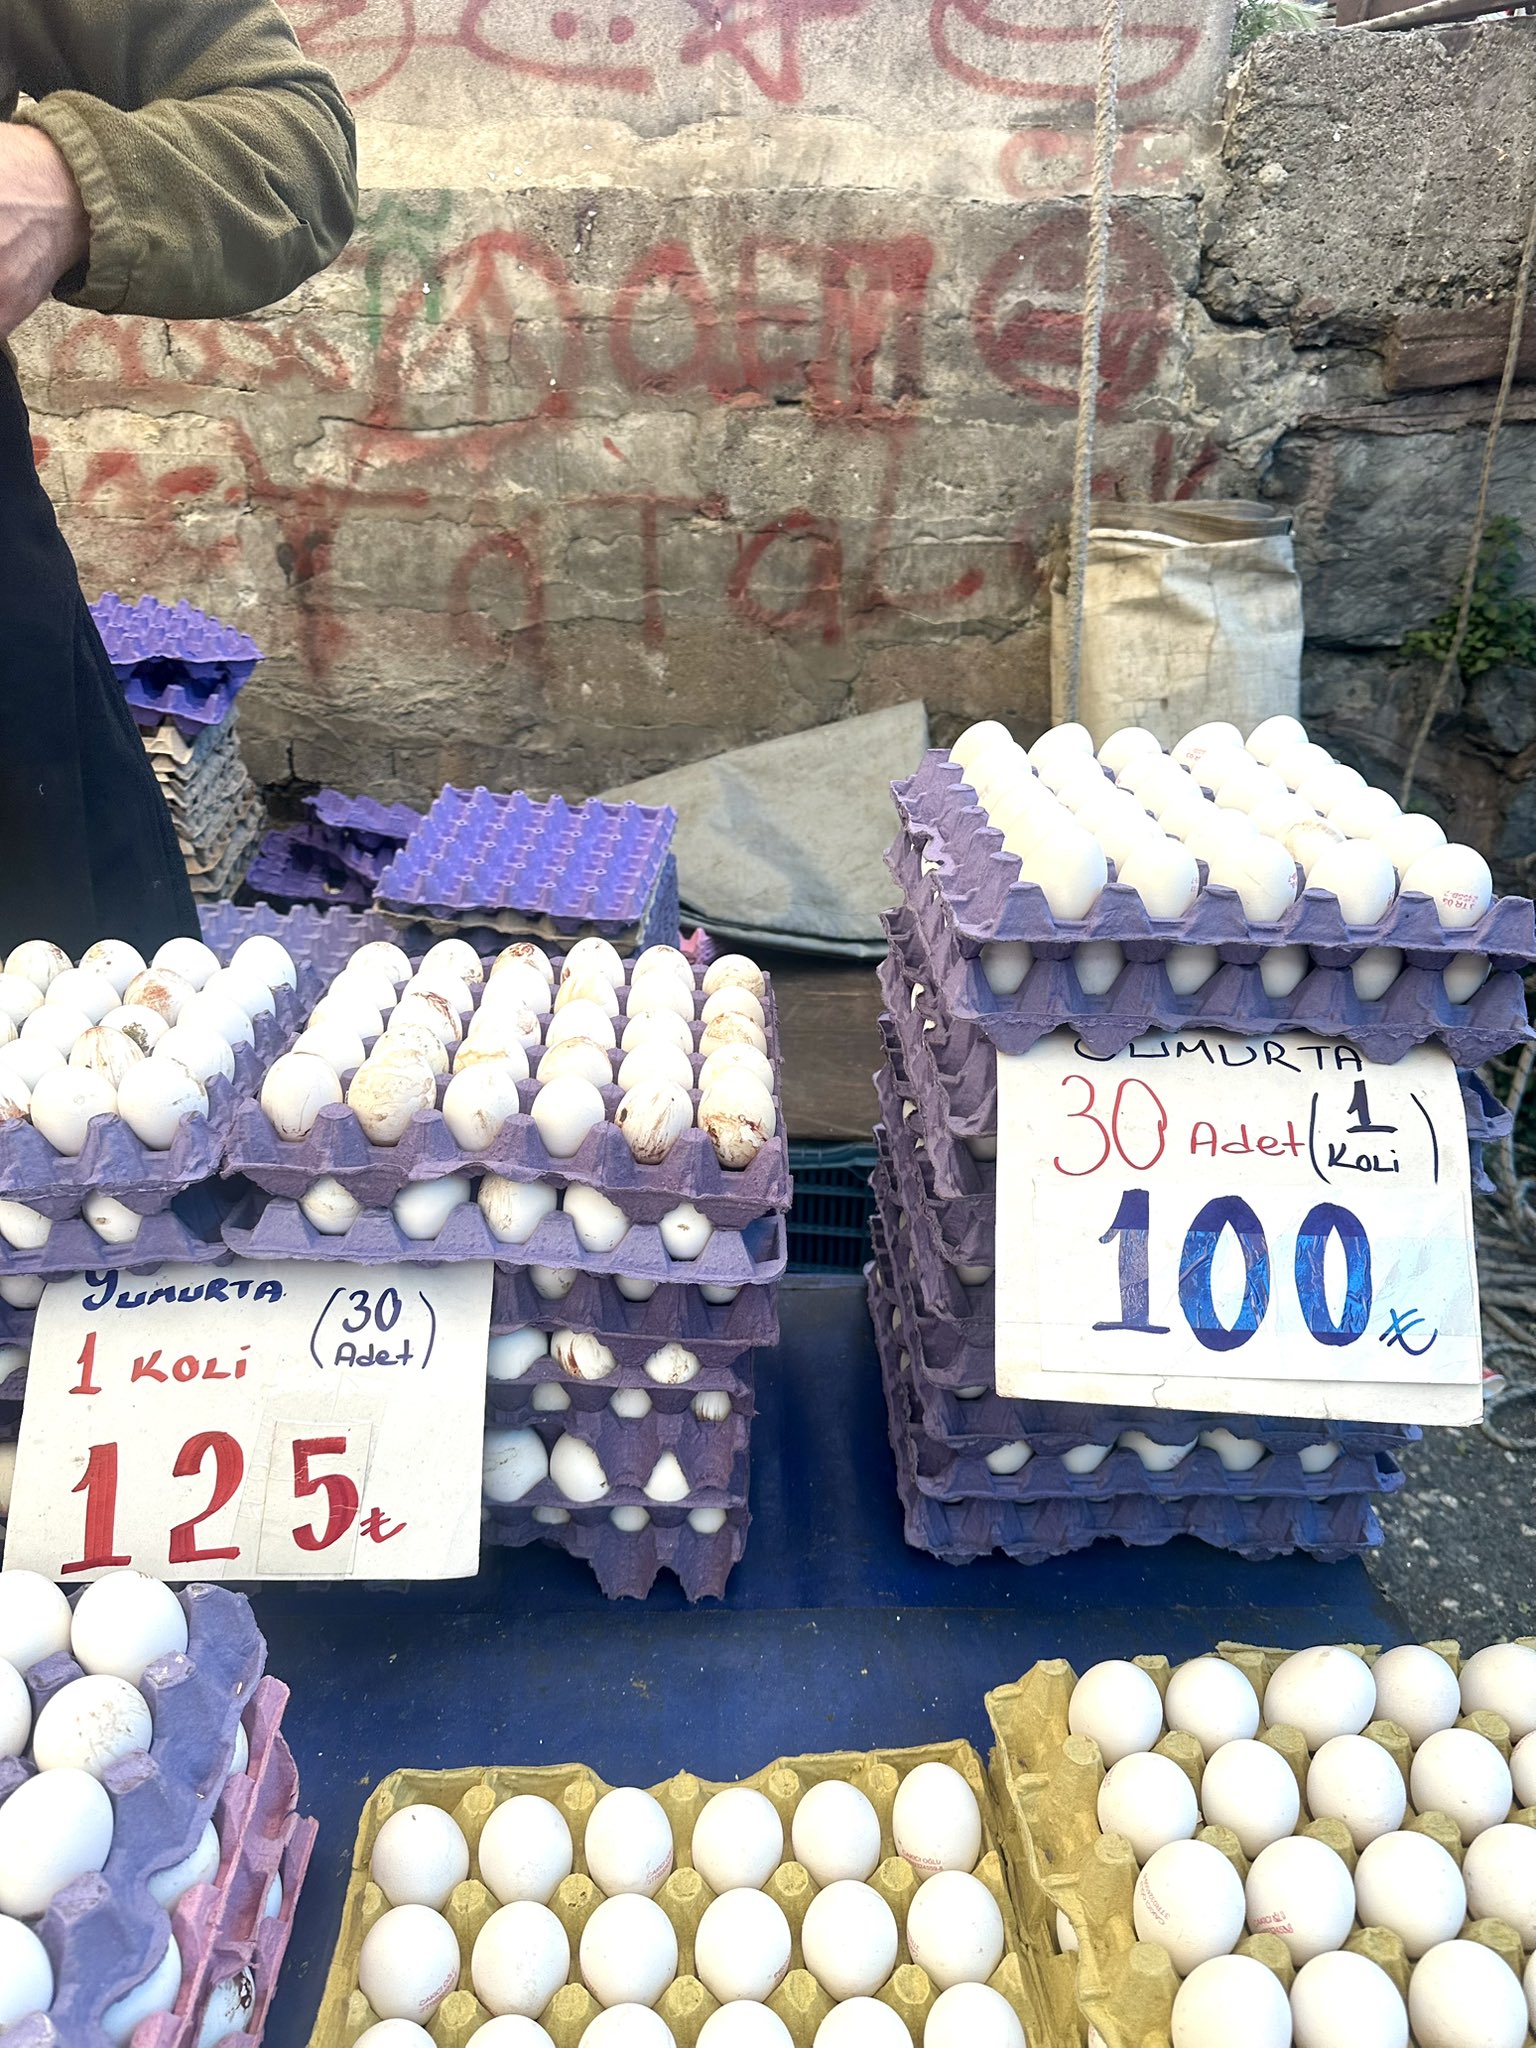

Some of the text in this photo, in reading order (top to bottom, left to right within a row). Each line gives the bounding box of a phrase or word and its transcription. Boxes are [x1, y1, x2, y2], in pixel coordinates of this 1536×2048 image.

[1053, 1075, 1167, 1176] 30
[1190, 1120, 1305, 1157] Adet
[68, 1331, 102, 1395] 1
